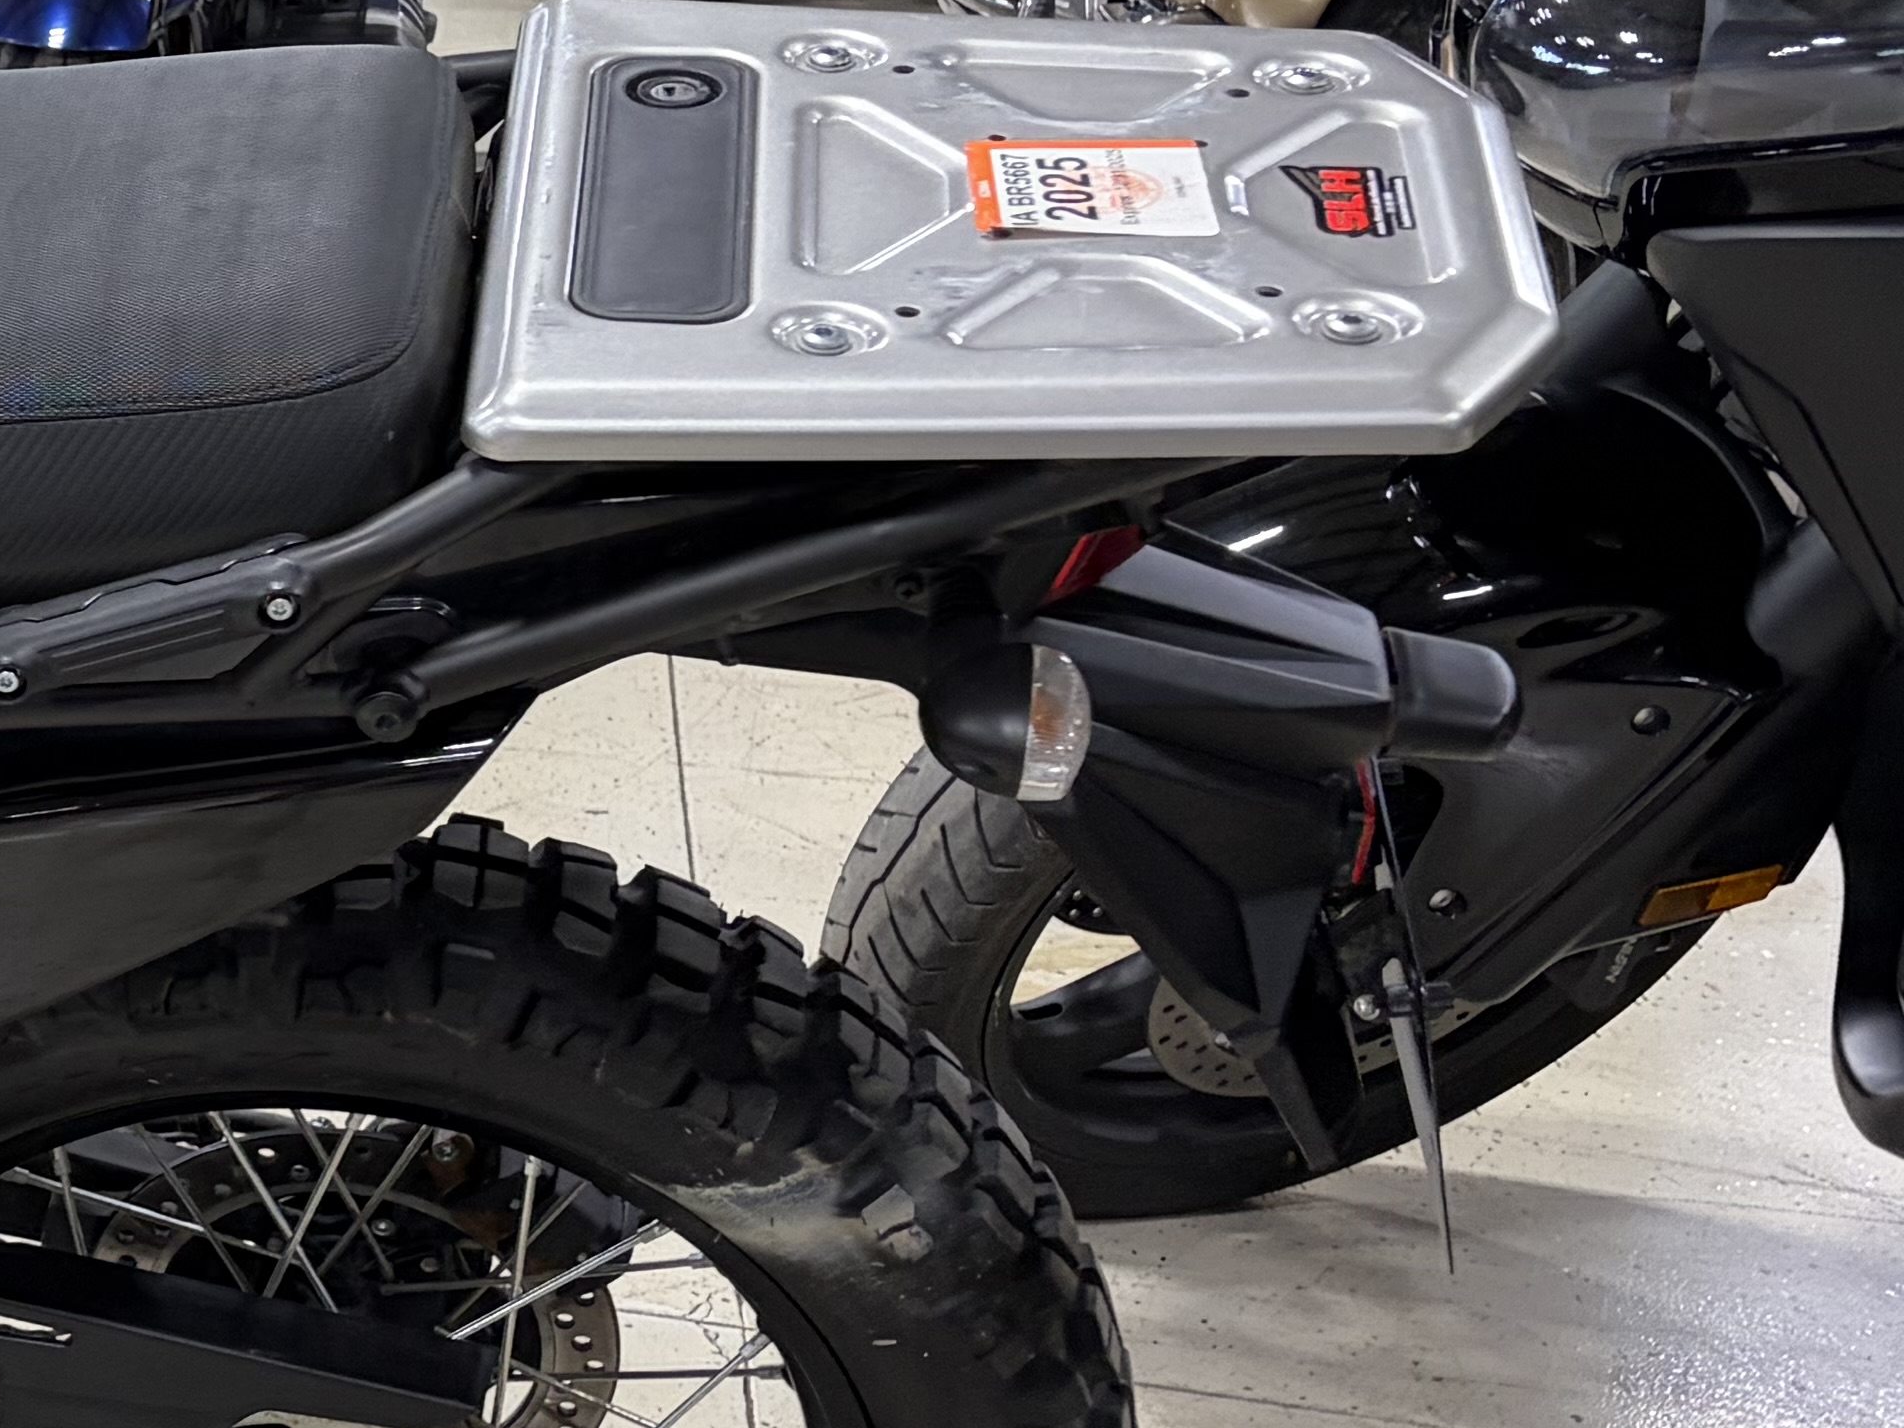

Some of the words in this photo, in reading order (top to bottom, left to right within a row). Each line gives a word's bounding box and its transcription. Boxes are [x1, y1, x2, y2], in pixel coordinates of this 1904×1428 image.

[1000, 153, 1036, 207] BR5667
[1036, 157, 1098, 221] 2025
[1318, 169, 1370, 232] SLH
[1009, 210, 1039, 226] IA
